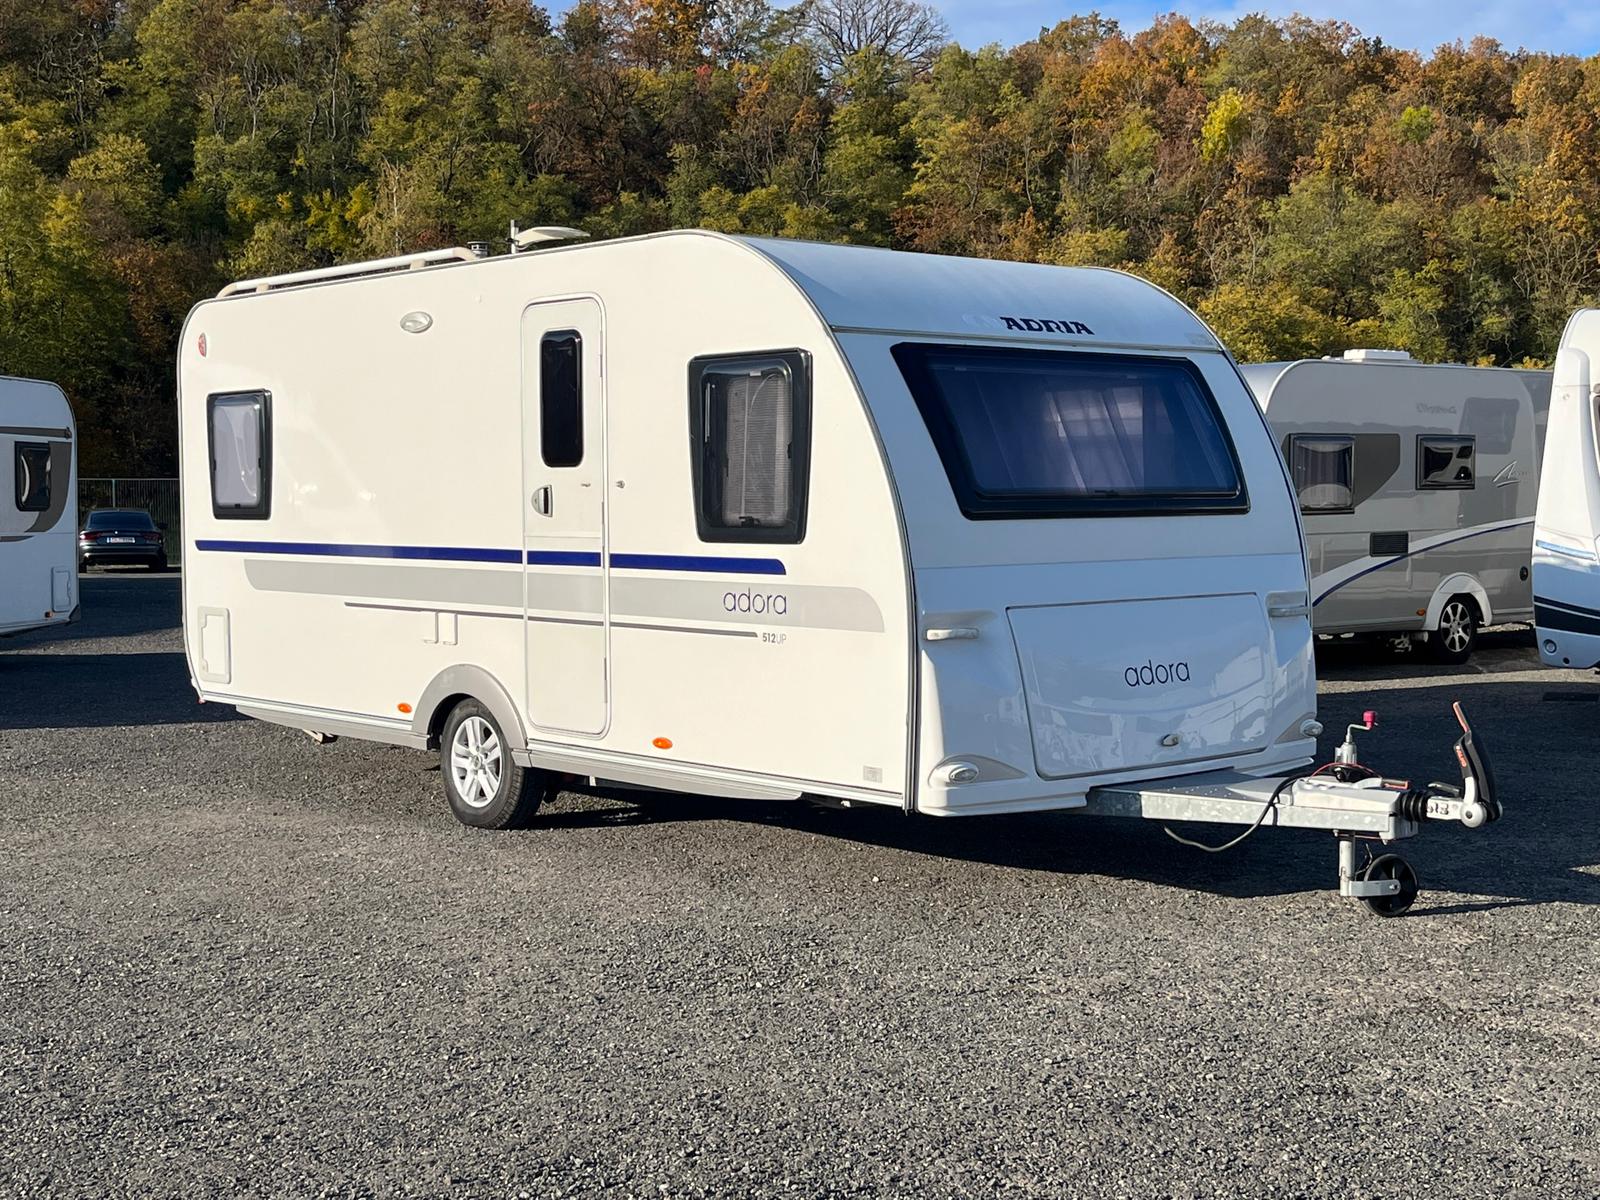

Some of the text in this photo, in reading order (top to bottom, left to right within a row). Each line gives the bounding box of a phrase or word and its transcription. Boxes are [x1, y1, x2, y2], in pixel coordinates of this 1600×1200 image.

[1000, 316, 1095, 335] ADRIA
[723, 587, 787, 614] adora
[1124, 659, 1191, 687] adora
